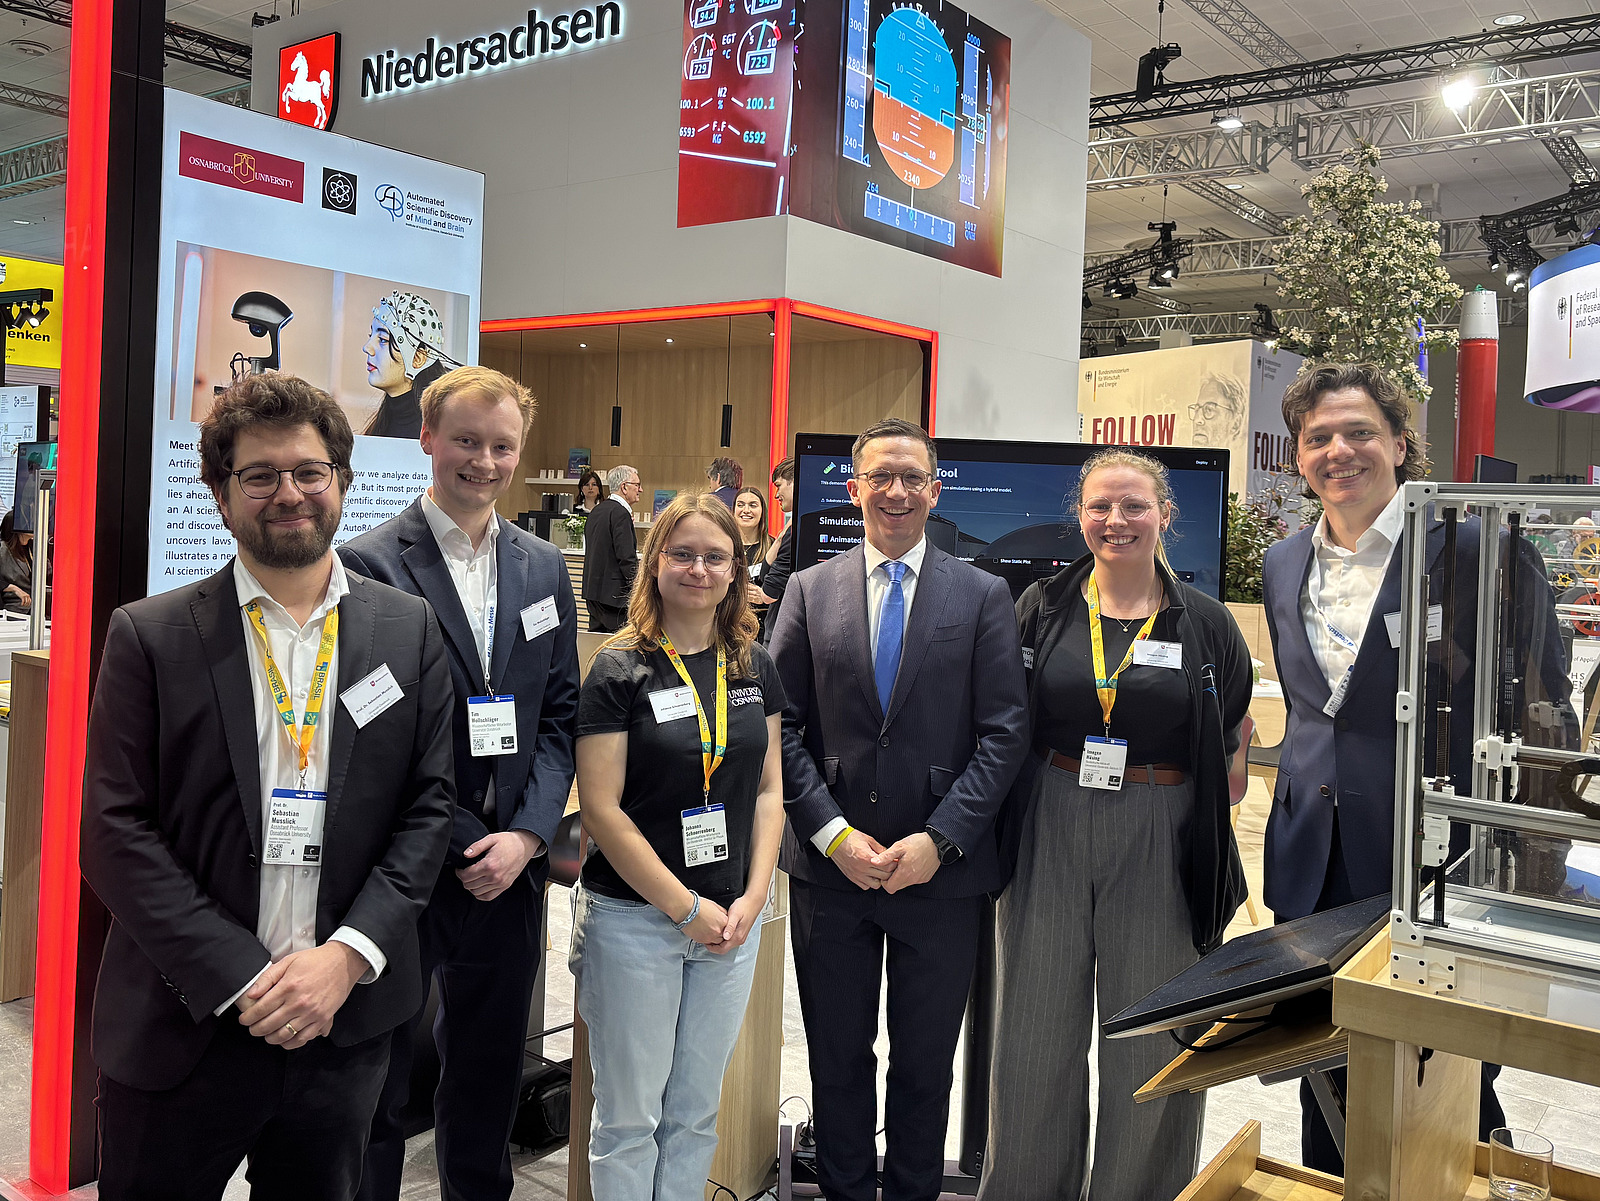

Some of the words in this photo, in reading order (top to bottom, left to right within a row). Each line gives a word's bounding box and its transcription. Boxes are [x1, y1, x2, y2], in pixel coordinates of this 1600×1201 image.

[700, 11, 714, 21] 94.4
[849, 18, 862, 32] 300
[722, 33, 736, 45] EGT
[749, 35, 754, 45] 5
[898, 31, 906, 41] 20
[966, 33, 981, 47] 6000
[767, 38, 777, 48] 10
[361, 1, 620, 98] Niedersachsen
[693, 46, 697, 54] 5
[706, 49, 713, 57] 10
[750, 56, 768, 68] 729
[848, 57, 860, 69] 280
[935, 53, 942, 63] 20
[694, 64, 707, 74] 729
[896, 63, 904, 74] 10
[933, 84, 940, 94] 10
[680, 99, 699, 109] 100.1
[746, 97, 775, 110] 100.1
[846, 96, 859, 109] 260
[712, 121, 727, 132] F.F
[680, 127, 696, 137] 6593
[712, 133, 722, 144] KG
[743, 131, 767, 144] 6592
[892, 131, 899, 142] 10
[845, 135, 858, 149] 240
[929, 150, 936, 161] 10
[188, 156, 234, 175] OSNABRÜCK
[254, 172, 294, 188] UNIVERSITY
[904, 170, 920, 186] 2340
[866, 181, 879, 194] 264
[406, 191, 445, 207] Automated
[406, 202, 439, 217] Scientific
[440, 209, 473, 226] Discovery
[877, 208, 882, 217] 5
[405, 213, 414, 221] of
[414, 215, 432, 226] Mind
[433, 220, 446, 229] and
[447, 222, 465, 233] Brain
[895, 216, 900, 226] 6
[914, 221, 918, 229] 7
[947, 233, 952, 244] 9
[1576, 288, 1597, 302] Federal
[1576, 304, 1582, 315] of
[1583, 302, 1600, 314] Resea
[1575, 316, 1586, 328] and
[7, 330, 51, 343] enken
[1092, 413, 1176, 446] FOLLOW
[169, 440, 194, 451] Meet
[1253, 431, 1291, 472] FOLLO
[168, 459, 200, 469] Artifici
[353, 470, 366, 478] ow
[381, 471, 409, 481] analyze
[412, 472, 428, 481] data
[936, 467, 958, 478] Tool
[167, 475, 202, 486] comple
[167, 489, 183, 499] lies
[349, 484, 359, 493] ry.
[361, 483, 374, 492] But
[376, 483, 385, 492] its
[386, 485, 404, 493] most
[406, 485, 426, 494] profo
[344, 497, 373, 506] cientific
[375, 497, 411, 507] discovery.
[183, 506, 193, 514] AI
[196, 506, 219, 515] scien
[350, 511, 396, 520] experiments
[166, 521, 184, 530] and
[188, 521, 225, 531] discover
[166, 537, 207, 545] uncovers
[212, 536, 232, 545] laws
[829, 535, 862, 544] Animated
[165, 550, 210, 560] illustrates
[164, 567, 175, 576] AI
[177, 567, 218, 577] scientists
[267, 665, 280, 694] BRASIL
[313, 672, 326, 701] BRASIL
[272, 809, 300, 817] Sebastian
